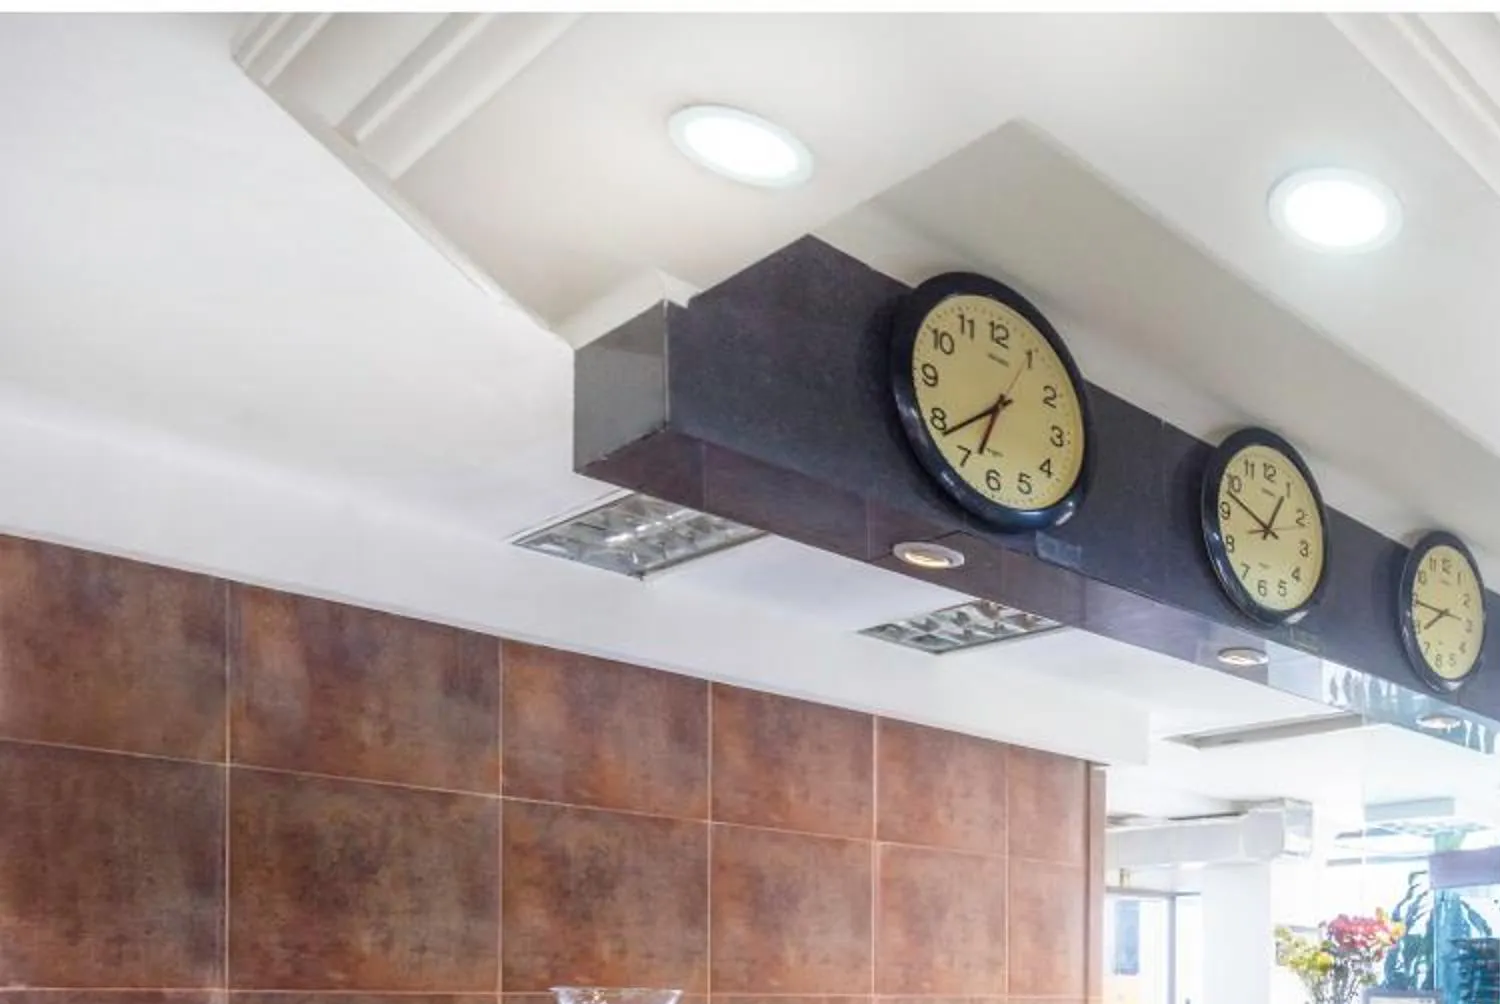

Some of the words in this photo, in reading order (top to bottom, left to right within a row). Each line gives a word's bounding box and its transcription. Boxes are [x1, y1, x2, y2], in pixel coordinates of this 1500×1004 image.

[958, 314, 975, 339] 11
[988, 320, 1009, 349] 12
[932, 328, 954, 355] 10
[1025, 349, 1033, 368] 1
[921, 363, 938, 387] 9
[1043, 385, 1057, 408] 2
[930, 407, 946, 431] 8
[1050, 425, 1064, 447] 3
[957, 444, 971, 467] 7
[1039, 459, 1053, 478] 4
[1244, 459, 1254, 480] 11
[1263, 463, 1276, 483] 12
[985, 469, 1001, 491] 6
[1017, 472, 1032, 495] 5
[1220, 501, 1230, 520] 9
[1296, 509, 1305, 526] 2
[1226, 535, 1235, 553] 8
[1300, 540, 1308, 557] 3
[1240, 563, 1250, 579] 7
[1291, 567, 1300, 582] 4
[1257, 580, 1267, 597] 6
[1278, 580, 1287, 597] 5
